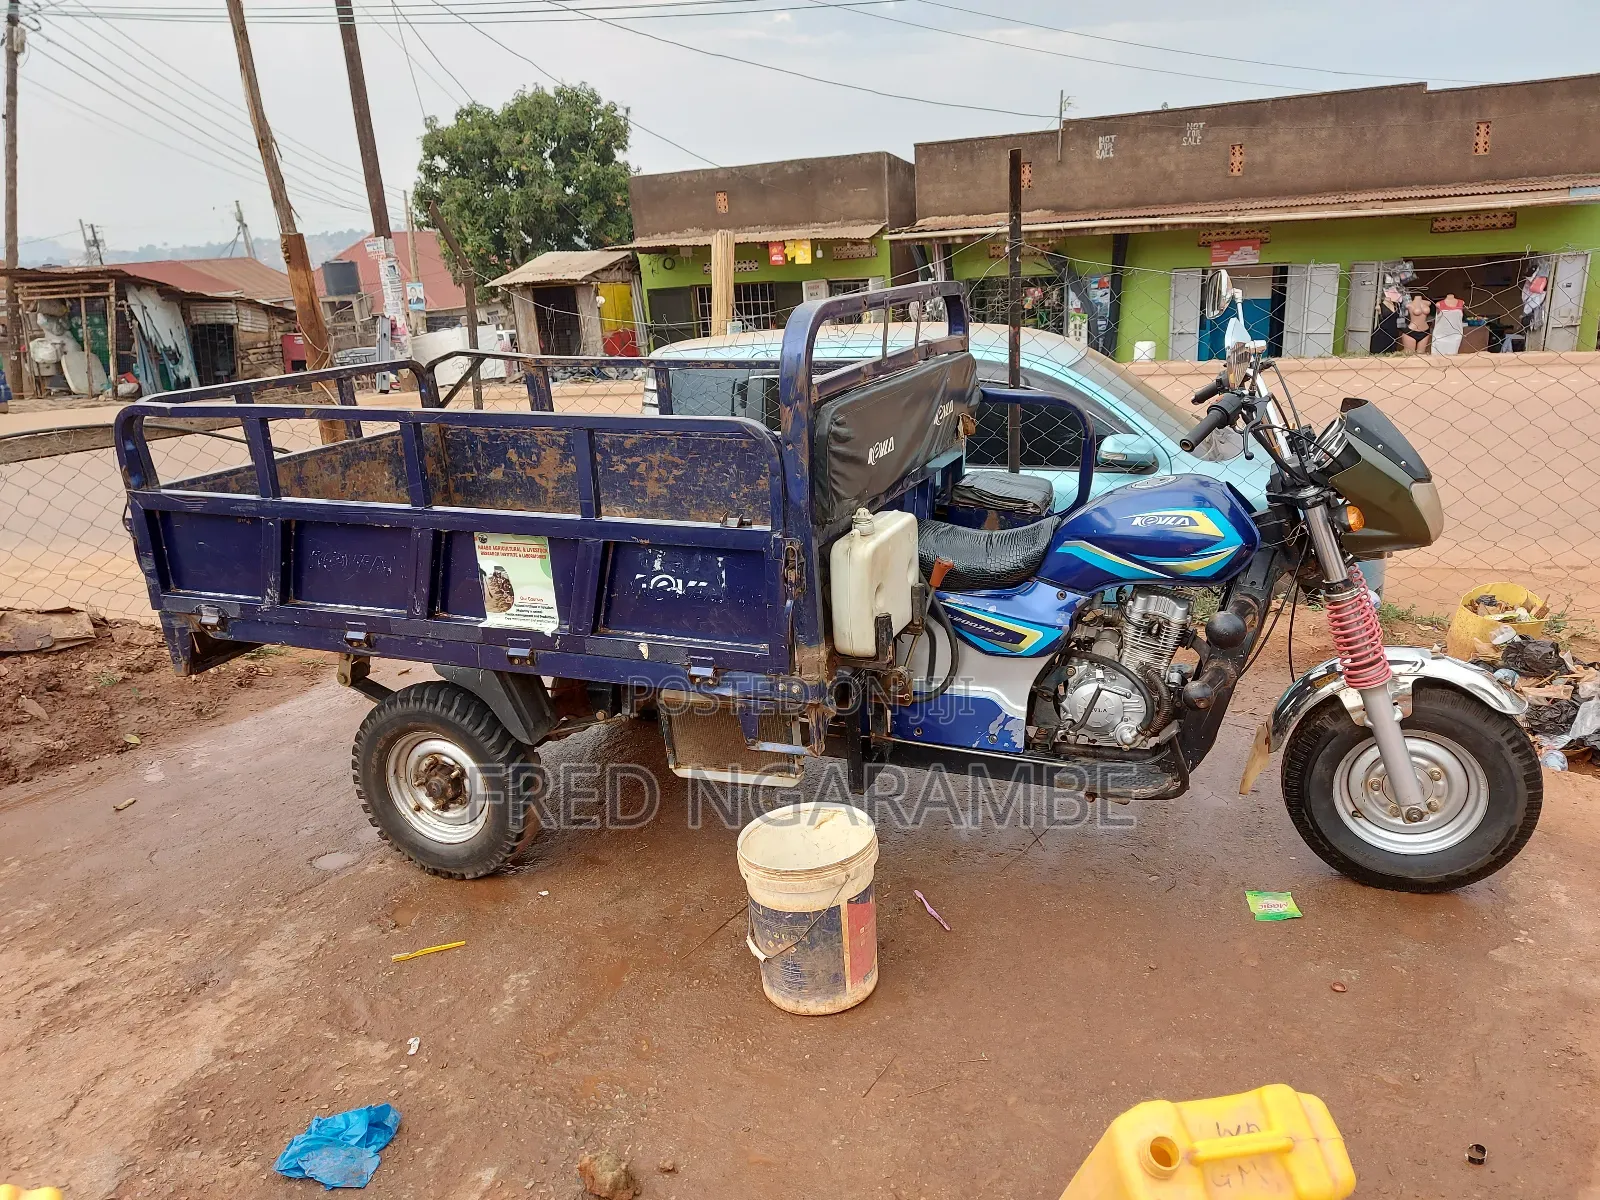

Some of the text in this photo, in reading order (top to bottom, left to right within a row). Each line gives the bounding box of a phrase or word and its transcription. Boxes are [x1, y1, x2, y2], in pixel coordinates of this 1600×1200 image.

[1186, 122, 1206, 130] NOT
[1186, 129, 1201, 137] FOR
[1098, 134, 1117, 143] NOT
[1182, 136, 1202, 146] SALE
[1098, 142, 1113, 150] FOR
[1095, 149, 1114, 160] SALE
